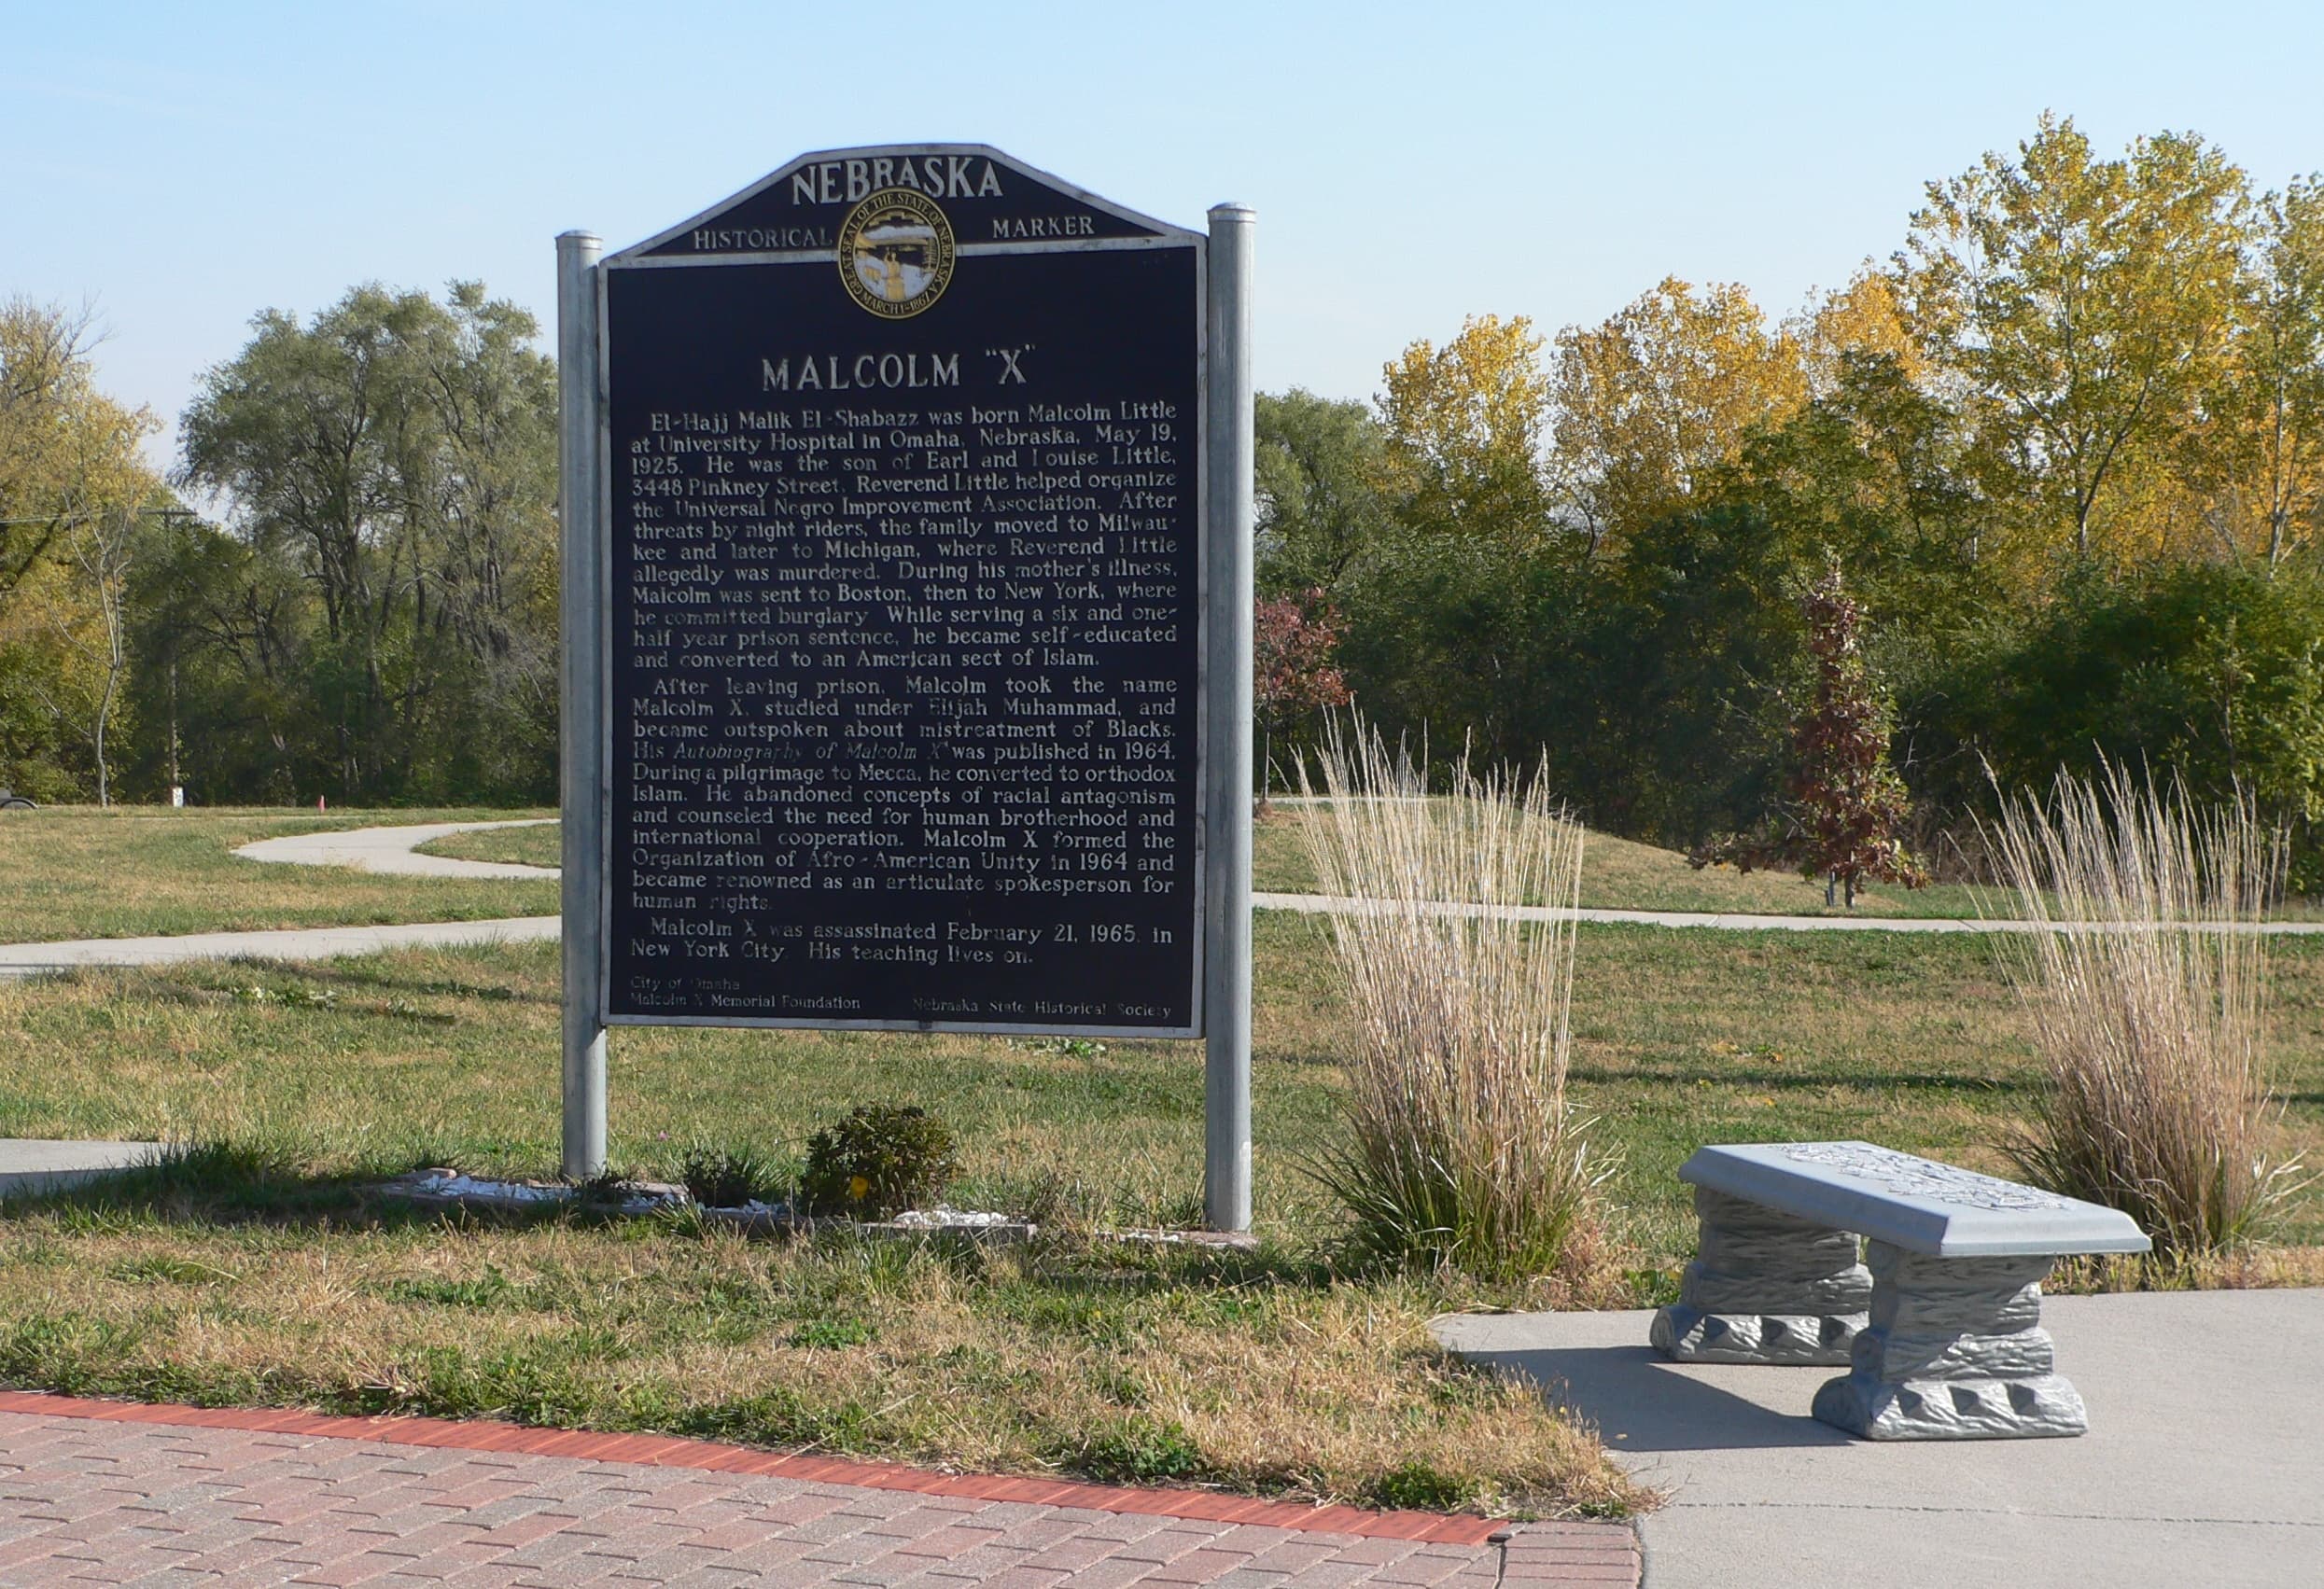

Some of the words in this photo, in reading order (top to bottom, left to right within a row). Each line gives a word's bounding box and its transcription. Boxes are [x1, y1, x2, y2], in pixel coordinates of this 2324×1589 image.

[791, 157, 1003, 205] NEBRASKA
[857, 203, 870, 221] OF
[872, 193, 895, 209] THE
[897, 193, 930, 215] STATE
[929, 210, 943, 226] OF
[992, 216, 1096, 239] MARKER
[693, 227, 833, 251] HISTORICAL
[843, 222, 860, 253] SEAL
[929, 226, 952, 294] NEBRASKA
[842, 257, 862, 295] GREAT
[861, 291, 899, 314] MARCH
[762, 353, 960, 392] MALCOLM
[985, 343, 1037, 386] "X"
[738, 410, 791, 429] Malik
[971, 405, 1018, 424] born
[1028, 402, 1111, 423] Malcolm
[1120, 401, 1176, 421] Little
[659, 433, 762, 457] University
[770, 430, 854, 455] Hospital
[862, 431, 881, 448] in
[1095, 425, 1140, 449] May
[631, 455, 683, 474] 1925.
[707, 454, 734, 473] He
[842, 456, 877, 470] son
[892, 451, 913, 469] of
[927, 450, 968, 468] Earl
[981, 449, 1017, 467] and
[632, 478, 682, 496] 3448
[688, 476, 769, 500] Pinkney
[856, 473, 948, 493] Reverend
[954, 471, 1009, 491] Little
[1015, 470, 1081, 495] helped
[1087, 469, 1176, 494] organize
[842, 494, 972, 519] Improvement
[981, 492, 1100, 512] Association.
[1118, 491, 1176, 509] After
[633, 520, 703, 538] threats
[711, 520, 737, 543] by
[745, 519, 795, 542] night
[918, 516, 983, 540] family
[994, 514, 1057, 534] moved
[632, 542, 665, 560] kee
[730, 540, 777, 559] later
[937, 537, 997, 556] where
[1010, 536, 1104, 555] Reverend
[633, 563, 723, 587] allegedly
[777, 561, 880, 580] murdered.
[898, 560, 967, 584] During
[977, 559, 1005, 578] his
[1015, 558, 1099, 578] mother's
[632, 585, 710, 603] Malcolm
[761, 585, 801, 602] sent
[808, 585, 830, 602] to
[922, 582, 967, 601] then
[1004, 581, 1043, 600] New
[1116, 579, 1176, 599] where
[886, 605, 942, 623] While
[950, 605, 1024, 628] serving
[1032, 608, 1043, 621] a
[1052, 605, 1078, 621] six
[1087, 603, 1122, 621] and
[682, 632, 727, 650] year
[737, 628, 799, 650] prison
[913, 626, 935, 644] he
[946, 625, 1021, 644] became
[633, 649, 668, 667] and
[679, 649, 778, 667] converted
[821, 653, 845, 666] an
[856, 648, 951, 666] American
[961, 648, 1001, 666] sect
[1043, 647, 1099, 665] Islam.
[653, 676, 708, 694] After
[905, 676, 986, 693] Malcolm
[1005, 675, 1052, 693] took
[1071, 675, 1104, 693] the
[1122, 679, 1177, 693] name
[632, 698, 713, 716] Malcolm
[764, 698, 839, 716] studied
[854, 697, 913, 716] under
[633, 719, 707, 737] became
[724, 719, 828, 743] outspoken
[844, 719, 903, 737] about
[919, 720, 1056, 737] mistreatment
[1107, 718, 1175, 737] Blacks.
[816, 741, 838, 759] of
[952, 746, 985, 759] was
[994, 741, 1089, 764] published
[1098, 742, 1116, 760] in
[1125, 741, 1175, 760] 1964.
[632, 762, 700, 786] During
[706, 767, 715, 780] a
[722, 762, 824, 786] pilgrimage
[929, 762, 950, 781] he
[956, 762, 1052, 781] converted
[1085, 763, 1176, 782] orthodox
[633, 784, 687, 801] Islam.
[707, 784, 731, 801] He
[744, 784, 852, 802] abandoned
[863, 786, 949, 808] concepts
[992, 785, 1049, 803] racial
[1060, 787, 1175, 809] antagonism
[632, 804, 667, 823] and
[677, 805, 773, 823] counseled
[826, 806, 872, 824] need
[881, 806, 911, 824] for
[919, 806, 989, 825] human
[1000, 807, 1127, 826] brotherhood
[1138, 807, 1174, 826] and
[633, 826, 761, 844] international
[777, 829, 903, 851] cooperation.
[923, 828, 1005, 847] Malcolm
[1023, 829, 1038, 847] X
[1053, 829, 1126, 848] formed
[1142, 829, 1174, 848] the
[632, 847, 763, 871] Organization
[775, 849, 796, 867] of
[980, 850, 1040, 874] Unity
[1080, 851, 1127, 870] 1964
[1137, 852, 1173, 871] and
[632, 869, 706, 887] became
[852, 875, 875, 889] an
[886, 871, 984, 890] articulate
[995, 872, 1131, 897] spokesperson
[1142, 873, 1173, 892] for
[632, 890, 696, 909] human
[651, 917, 732, 936] Malcolm
[814, 919, 936, 939] assassinated
[947, 921, 1042, 946] February
[1153, 926, 1171, 942] in
[631, 939, 670, 956] New
[683, 939, 729, 957] York
[808, 941, 840, 959] His
[851, 941, 938, 967] teaching
[1003, 949, 1032, 963] on.
[711, 996, 775, 1008] Memorial
[782, 997, 860, 1010] Foundation
